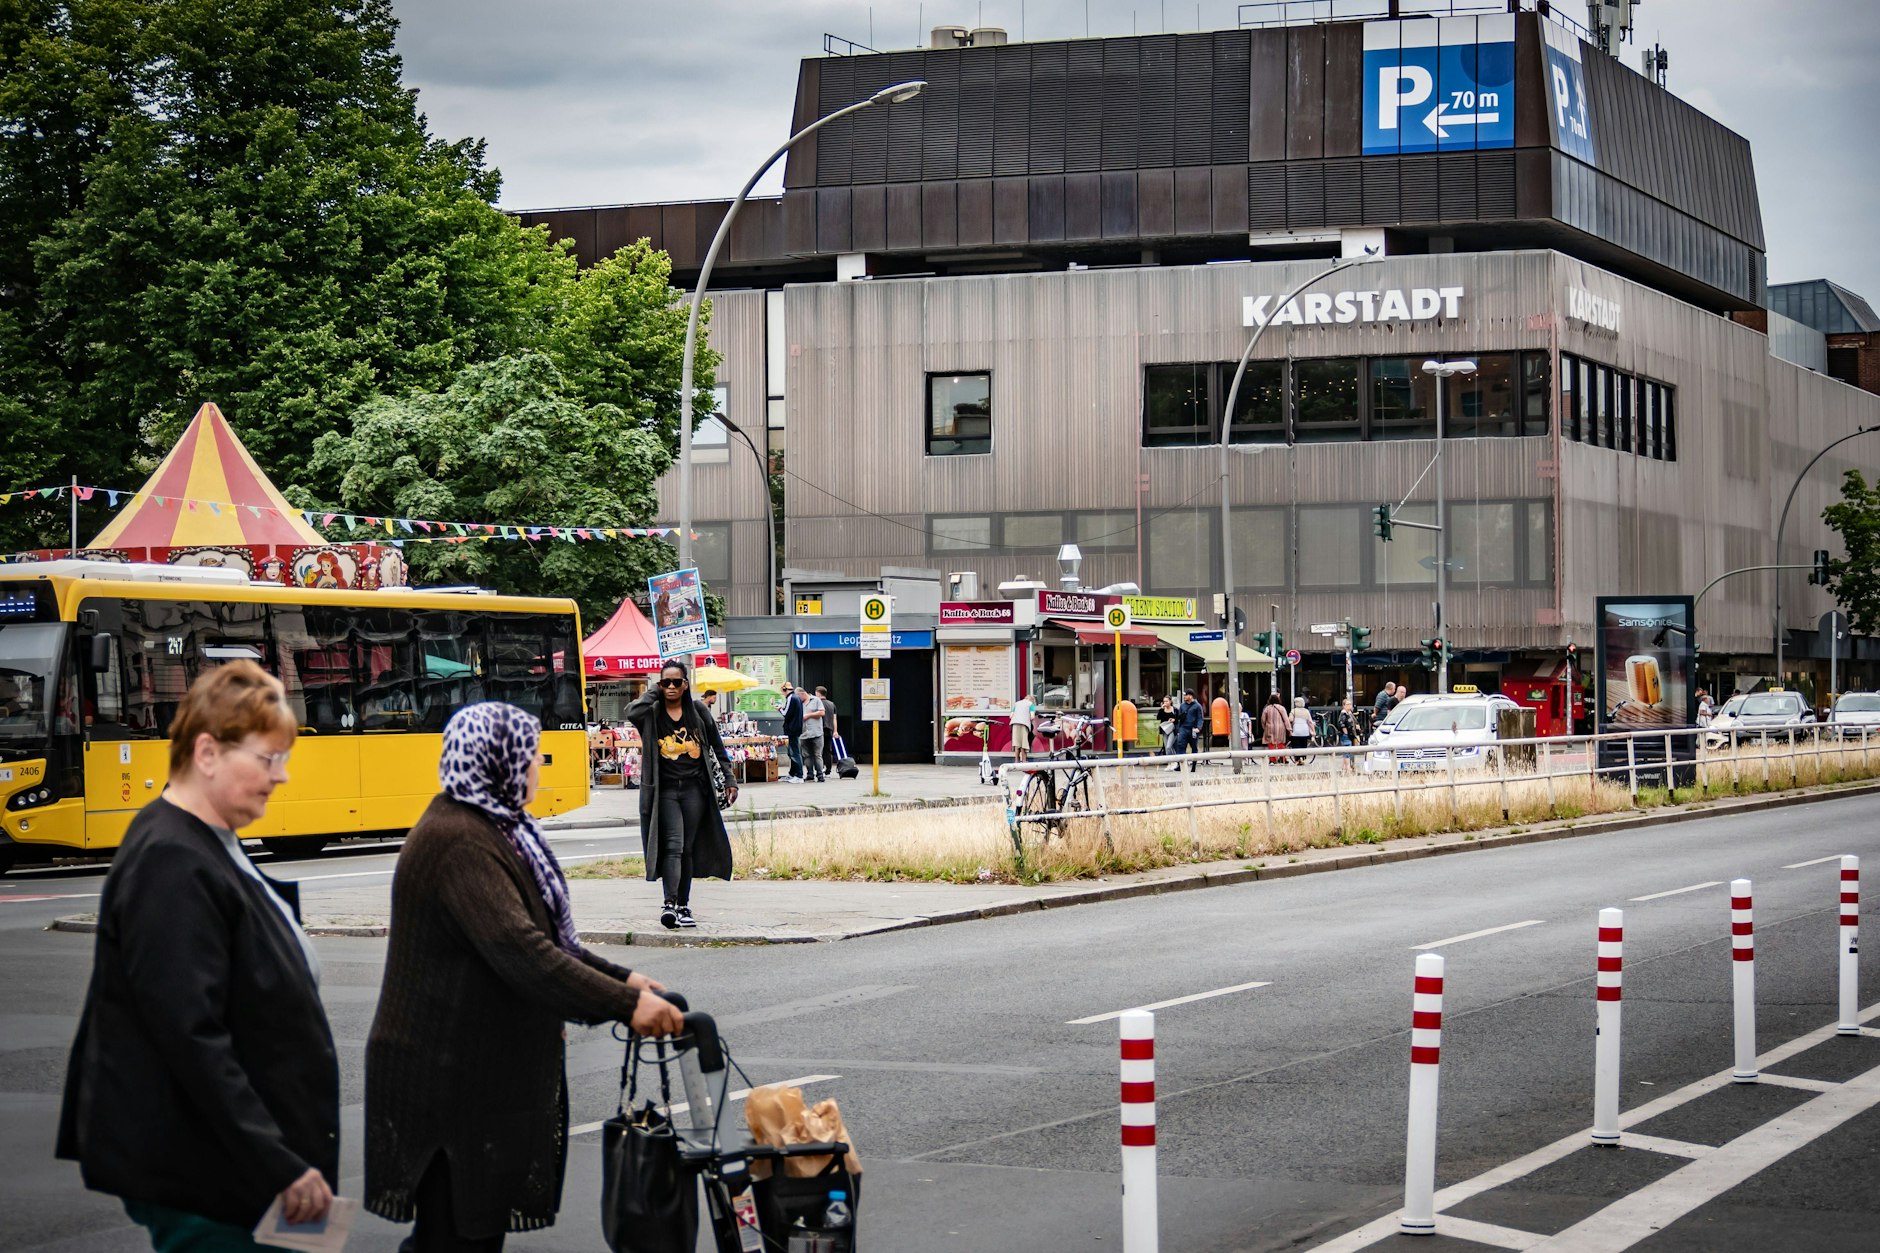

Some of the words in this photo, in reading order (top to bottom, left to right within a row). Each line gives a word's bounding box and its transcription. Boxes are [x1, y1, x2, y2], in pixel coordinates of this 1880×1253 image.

[1378, 65, 1433, 130] P
[1451, 91, 1475, 109] 70
[1479, 92, 1498, 108] m
[1551, 63, 1569, 128] P
[1242, 286, 1464, 327] KARSTADT
[1569, 286, 1621, 333] KARSTADT
[869, 603, 880, 615] H
[1046, 594, 1067, 611] Kaffee
[1155, 599, 1186, 618] STATION
[942, 608, 968, 618] Kaffee
[970, 609, 978, 618] &
[979, 609, 1001, 618] Back
[1112, 614, 1121, 622] H
[1618, 618, 1673, 628] Samsonite
[660, 627, 704, 640] BERLIN
[168, 637, 183, 655] 247
[795, 634, 807, 649] U
[617, 659, 635, 669] THE
[637, 657, 668, 669] COFFE
[559, 722, 584, 730] CITEA
[20, 767, 40, 776] 2406
